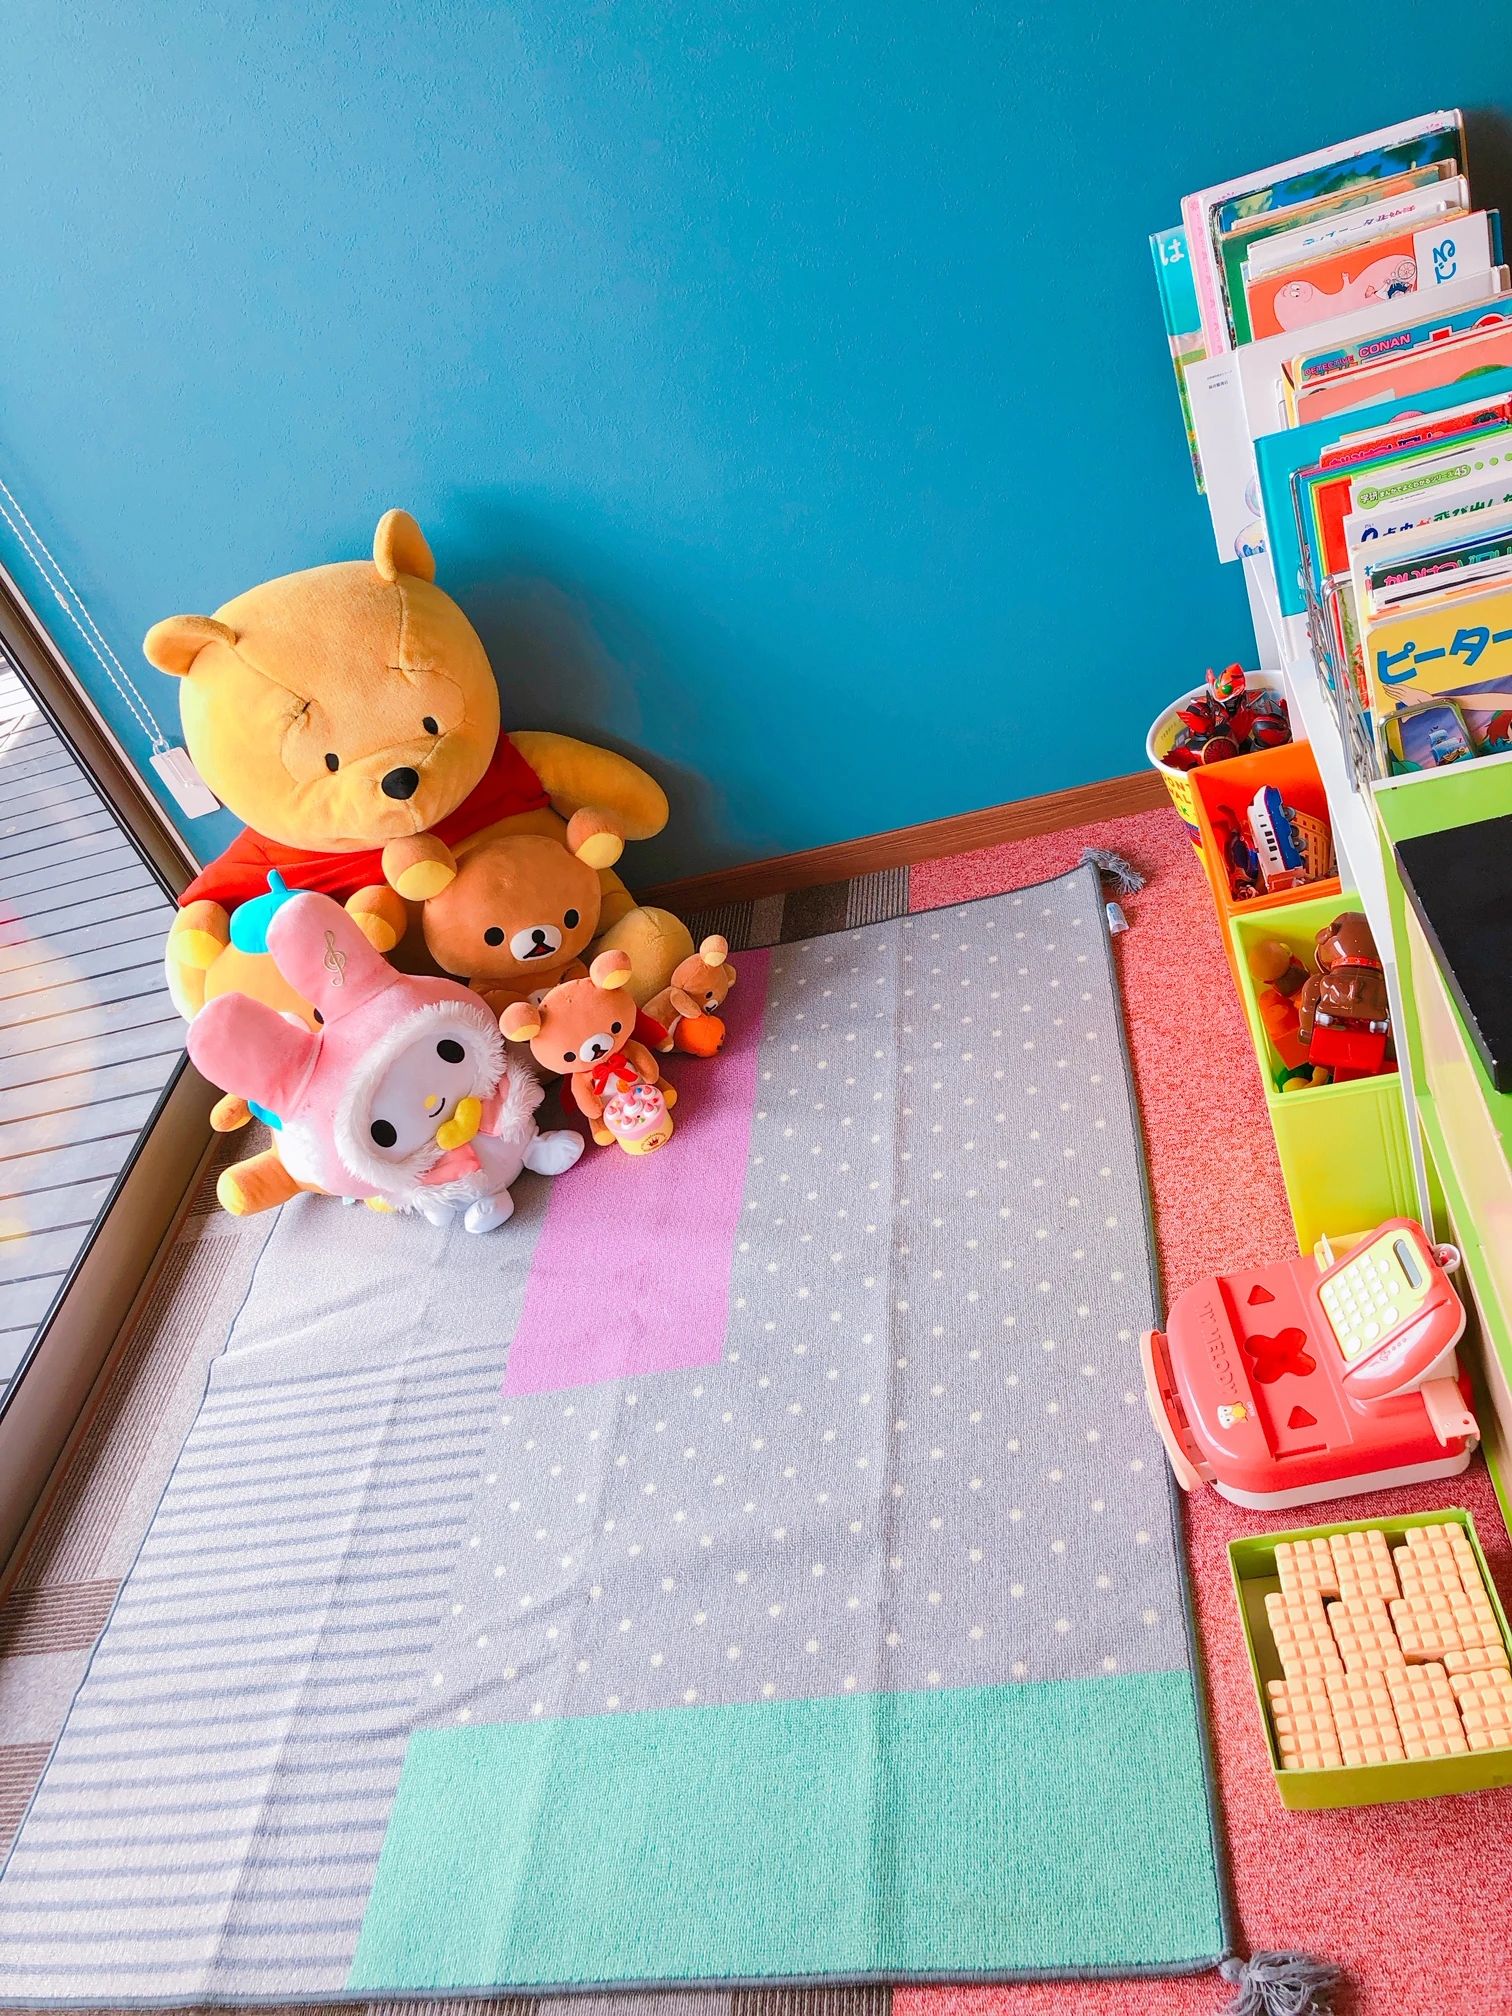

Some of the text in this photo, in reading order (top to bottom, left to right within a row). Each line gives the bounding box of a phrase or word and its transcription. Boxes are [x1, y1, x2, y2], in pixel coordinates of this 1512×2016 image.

[1159, 238, 1185, 266] は
[1432, 239, 1457, 285] でる
[1358, 333, 1412, 358] CONAN
